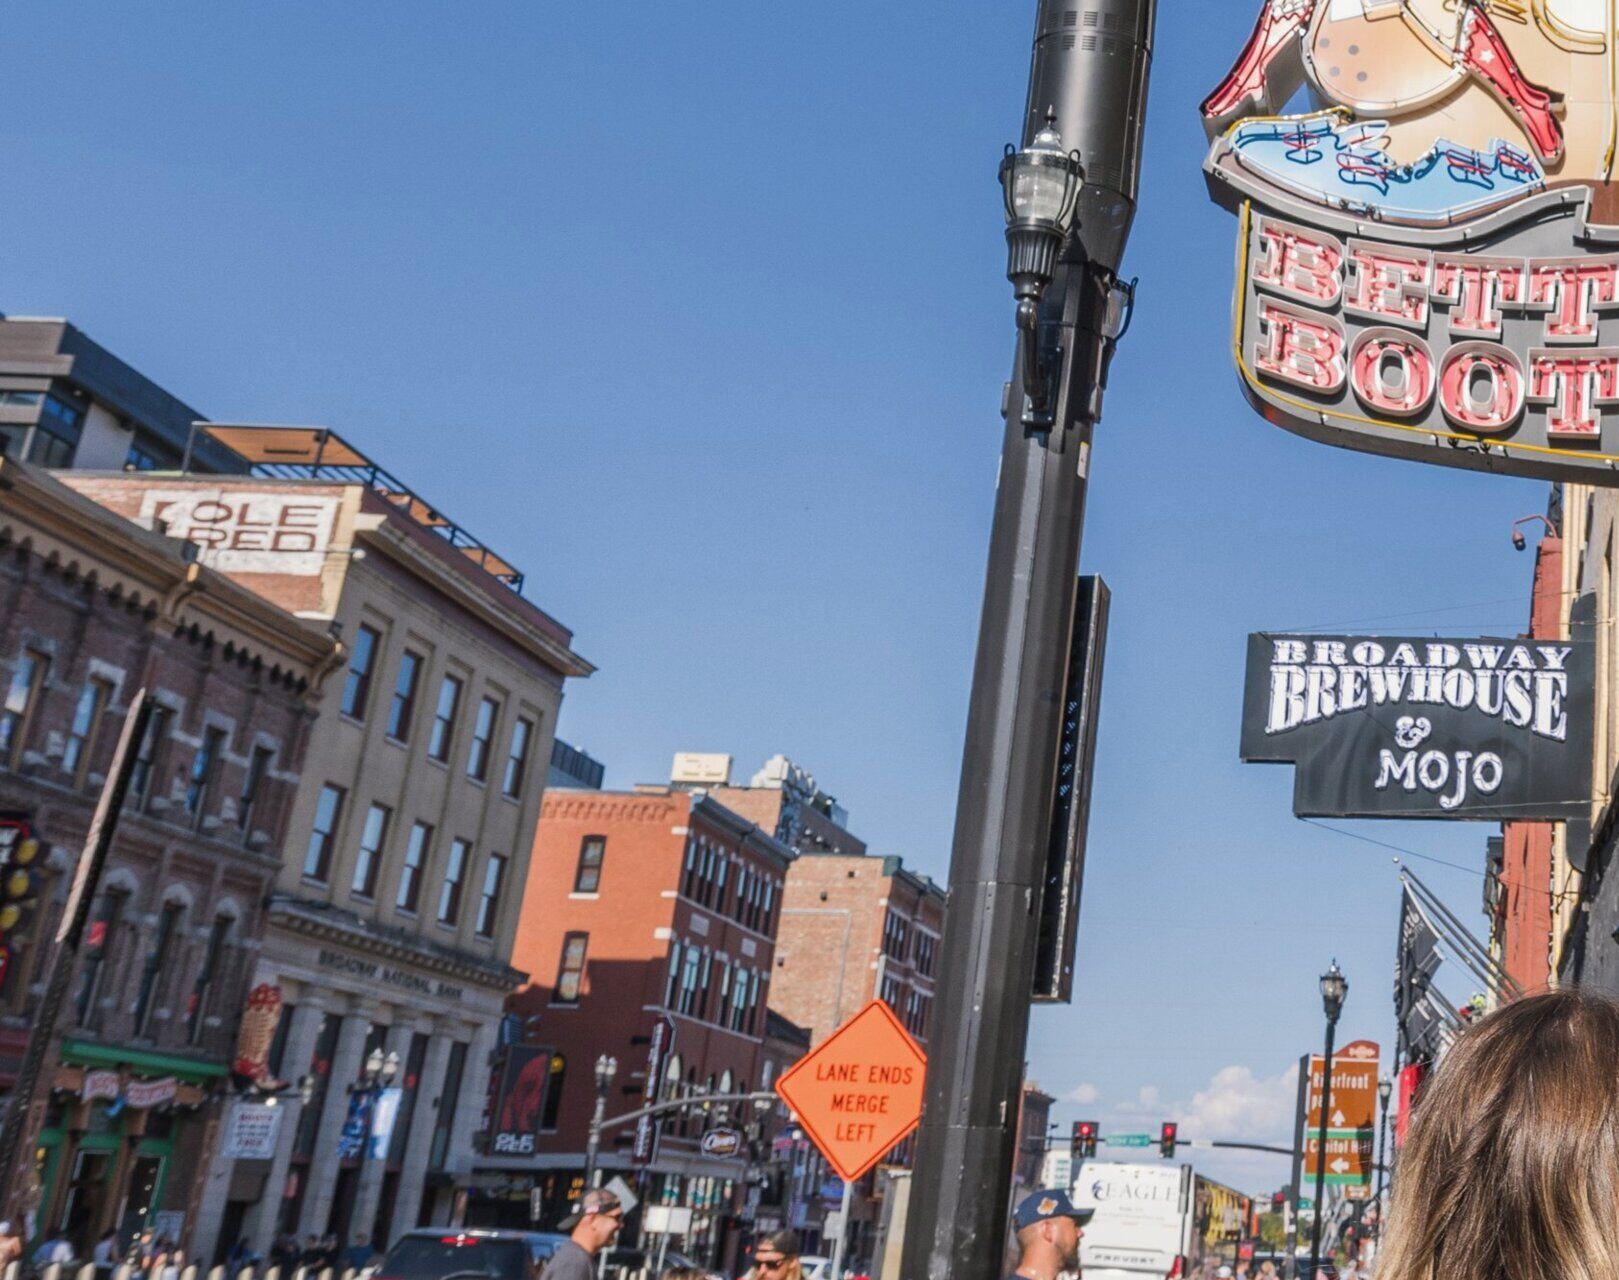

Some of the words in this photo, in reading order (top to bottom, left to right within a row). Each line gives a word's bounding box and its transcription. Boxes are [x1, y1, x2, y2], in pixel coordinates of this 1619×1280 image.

[191, 500, 324, 528] OLE
[187, 526, 317, 552] RED
[1271, 639, 1573, 671] BROADWAY
[1264, 664, 1569, 743] BREWHOUSE
[1393, 715, 1432, 749] &
[1374, 748, 1504, 810] MOJO
[815, 1063, 860, 1083] LANE
[868, 1066, 914, 1085] ENDS
[1313, 1072, 1369, 1089] Rierfront
[830, 1094, 890, 1114] MERGE
[835, 1123, 878, 1142] LEFT
[1309, 1139, 1349, 1154] Cpitol
[1105, 1182, 1177, 1201] EAGLE
[1094, 1254, 1156, 1265] PREVOST
